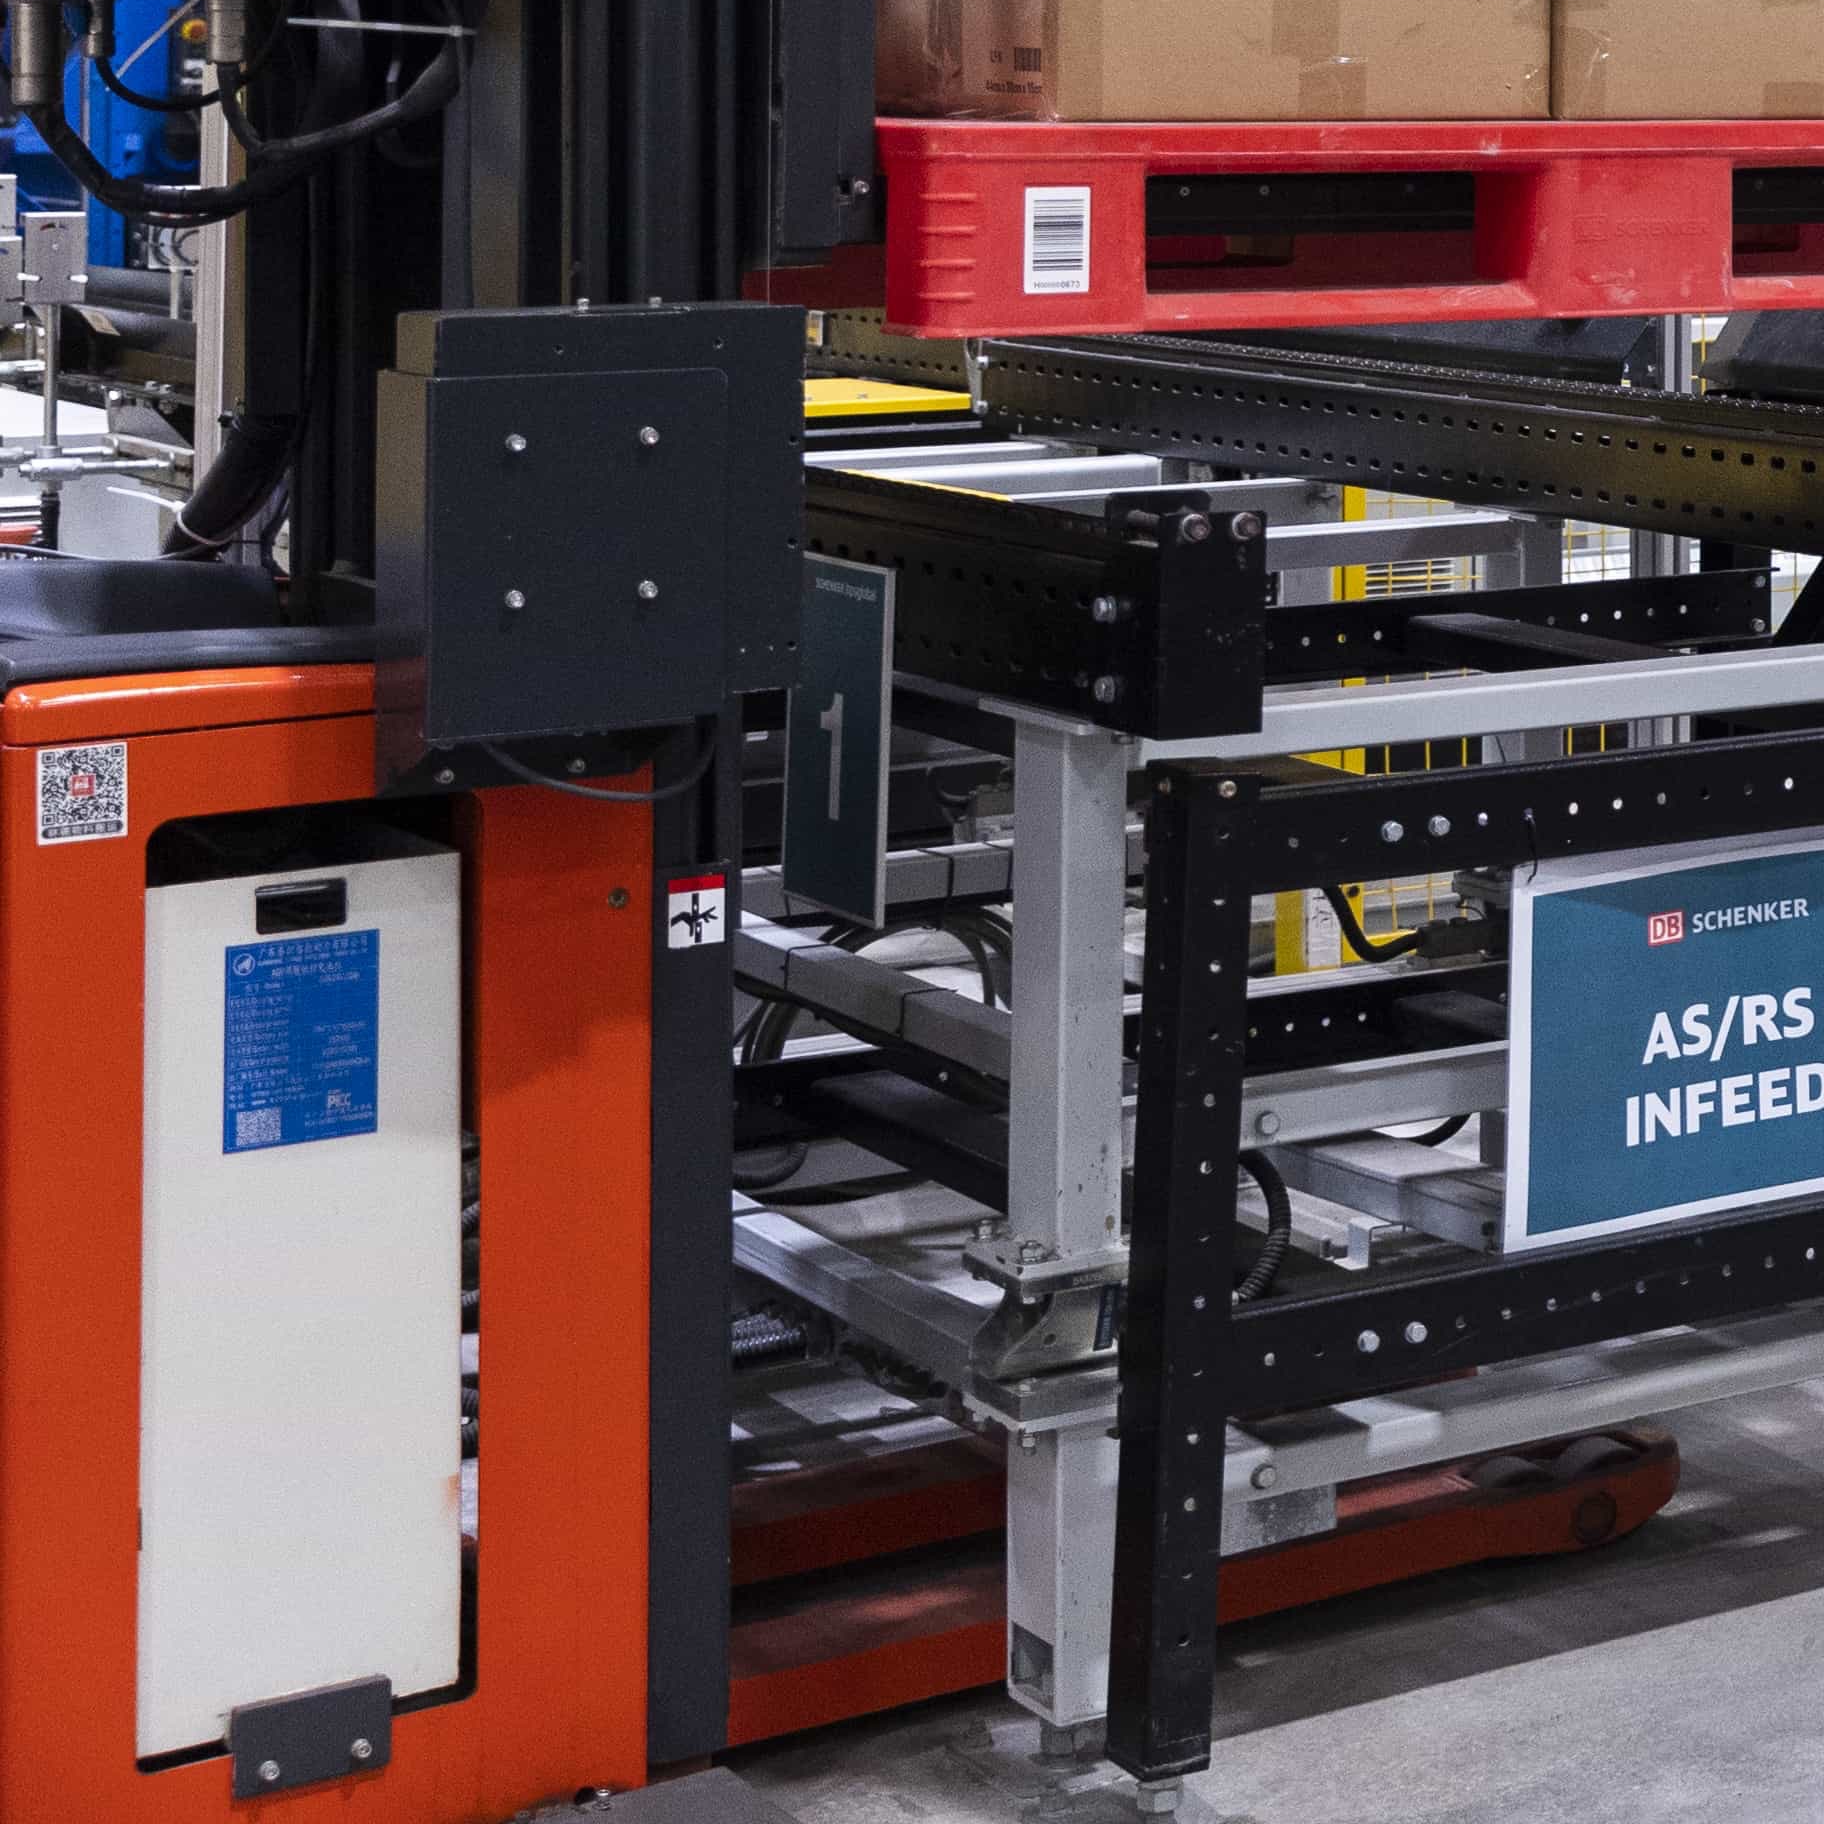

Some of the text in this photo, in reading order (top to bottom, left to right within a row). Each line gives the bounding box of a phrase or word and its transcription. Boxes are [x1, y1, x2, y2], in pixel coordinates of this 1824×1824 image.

[820, 692, 844, 821] 1
[1652, 898, 1809, 942] DB SCHENKER
[1642, 987, 1815, 1065] AS/RS
